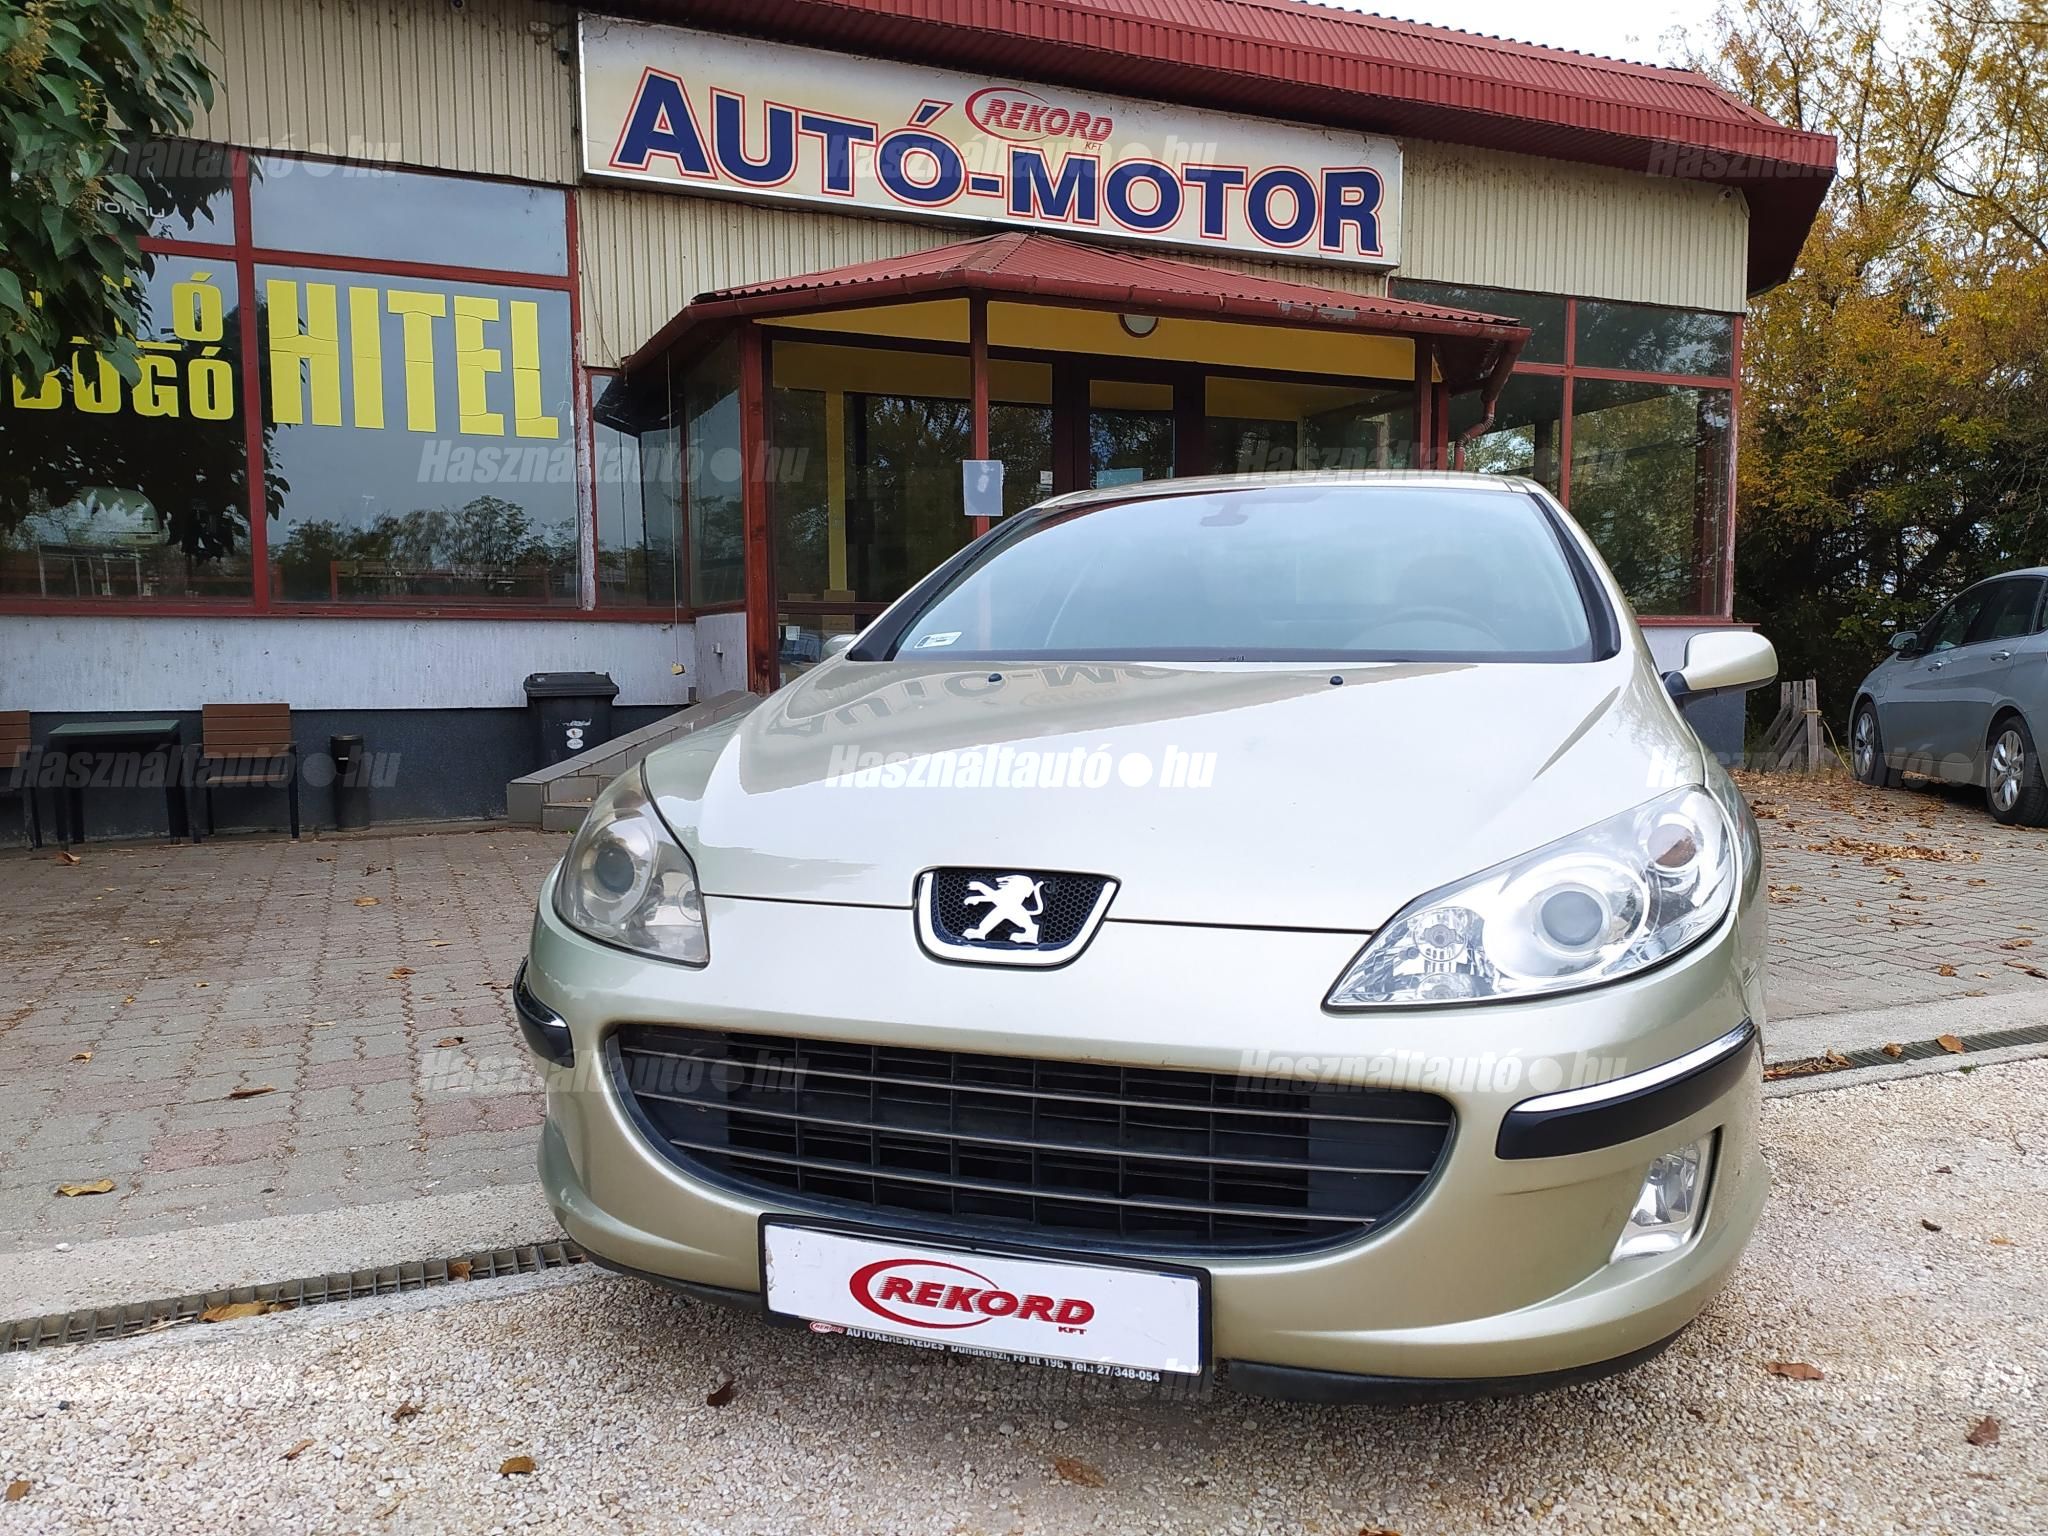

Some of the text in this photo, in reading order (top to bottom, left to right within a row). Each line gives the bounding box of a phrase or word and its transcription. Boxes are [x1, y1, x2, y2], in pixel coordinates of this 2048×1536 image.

[981, 98, 1114, 143] REKORD
[610, 66, 1384, 258] AUTÓ-MOTOR
[1084, 141, 1104, 151] KFT
[266, 279, 560, 440] HITEL
[876, 1276, 1095, 1325] REKORD
[1058, 1326, 1087, 1336] KFT
